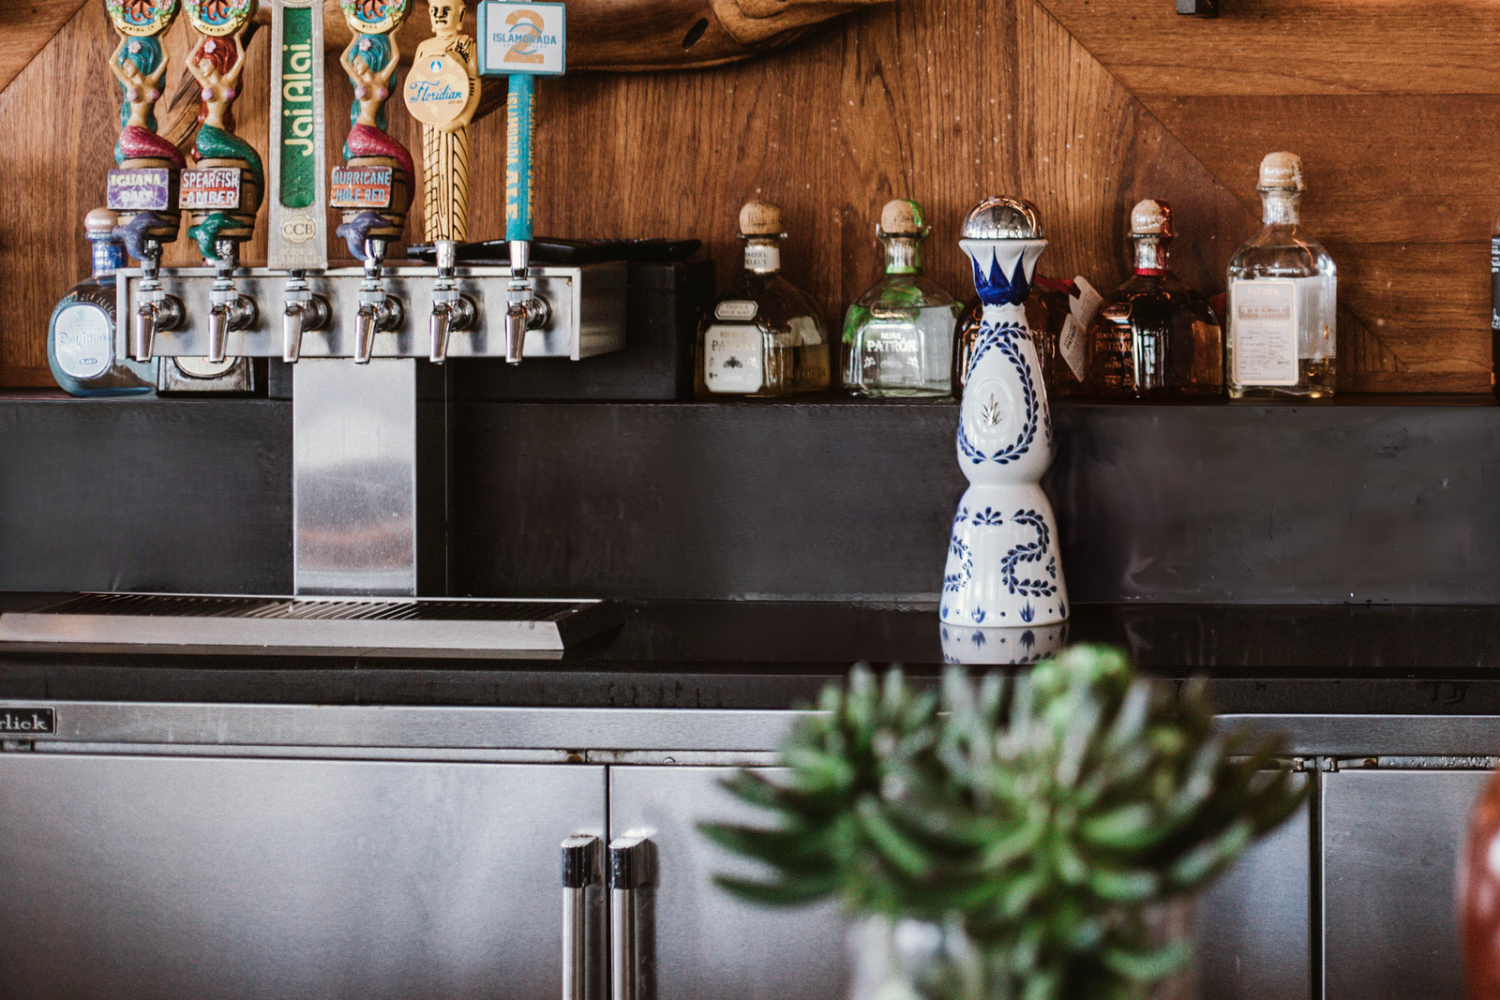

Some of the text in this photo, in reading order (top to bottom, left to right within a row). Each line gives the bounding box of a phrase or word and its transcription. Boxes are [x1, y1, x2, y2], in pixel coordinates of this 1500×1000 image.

[493, 32, 556, 45] ISLAMORADA
[503, 9, 545, 64] 2
[410, 80, 462, 103] Floridian
[282, 44, 314, 156] Jai Alai
[110, 174, 161, 186] IGUANA
[183, 172, 238, 188] SPEARFISH
[332, 171, 392, 185] HURRICANE
[187, 190, 236, 204] AMBER
[336, 188, 385, 202] HOLE RED
[506, 171, 518, 220] ALE
[284, 223, 314, 236] CCB
[59, 331, 80, 344] Don
[867, 339, 918, 352] PATRÓN
[0, 714, 48, 730] rlick
